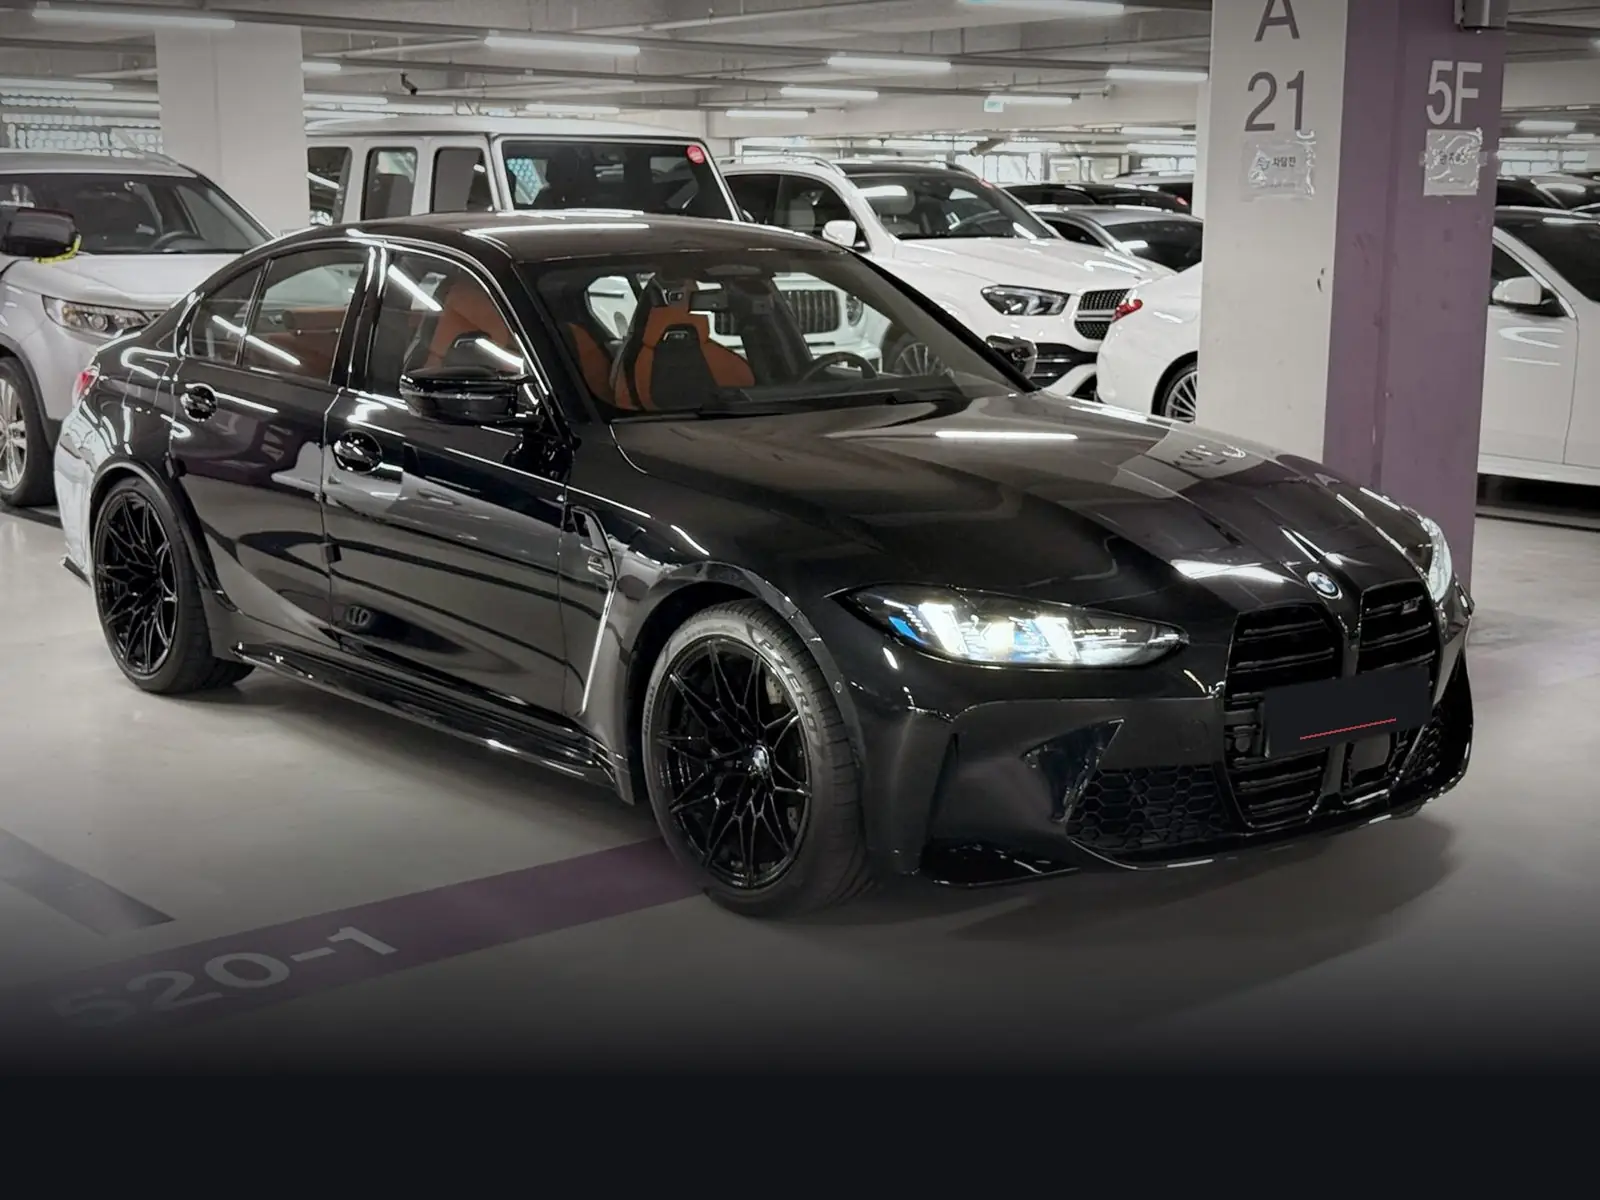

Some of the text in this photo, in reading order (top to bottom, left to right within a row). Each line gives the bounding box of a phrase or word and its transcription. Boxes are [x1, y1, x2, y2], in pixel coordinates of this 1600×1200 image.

[1254, 0, 1300, 42] A
[1244, 70, 1305, 132] 21
[1426, 60, 1483, 125] 5F
